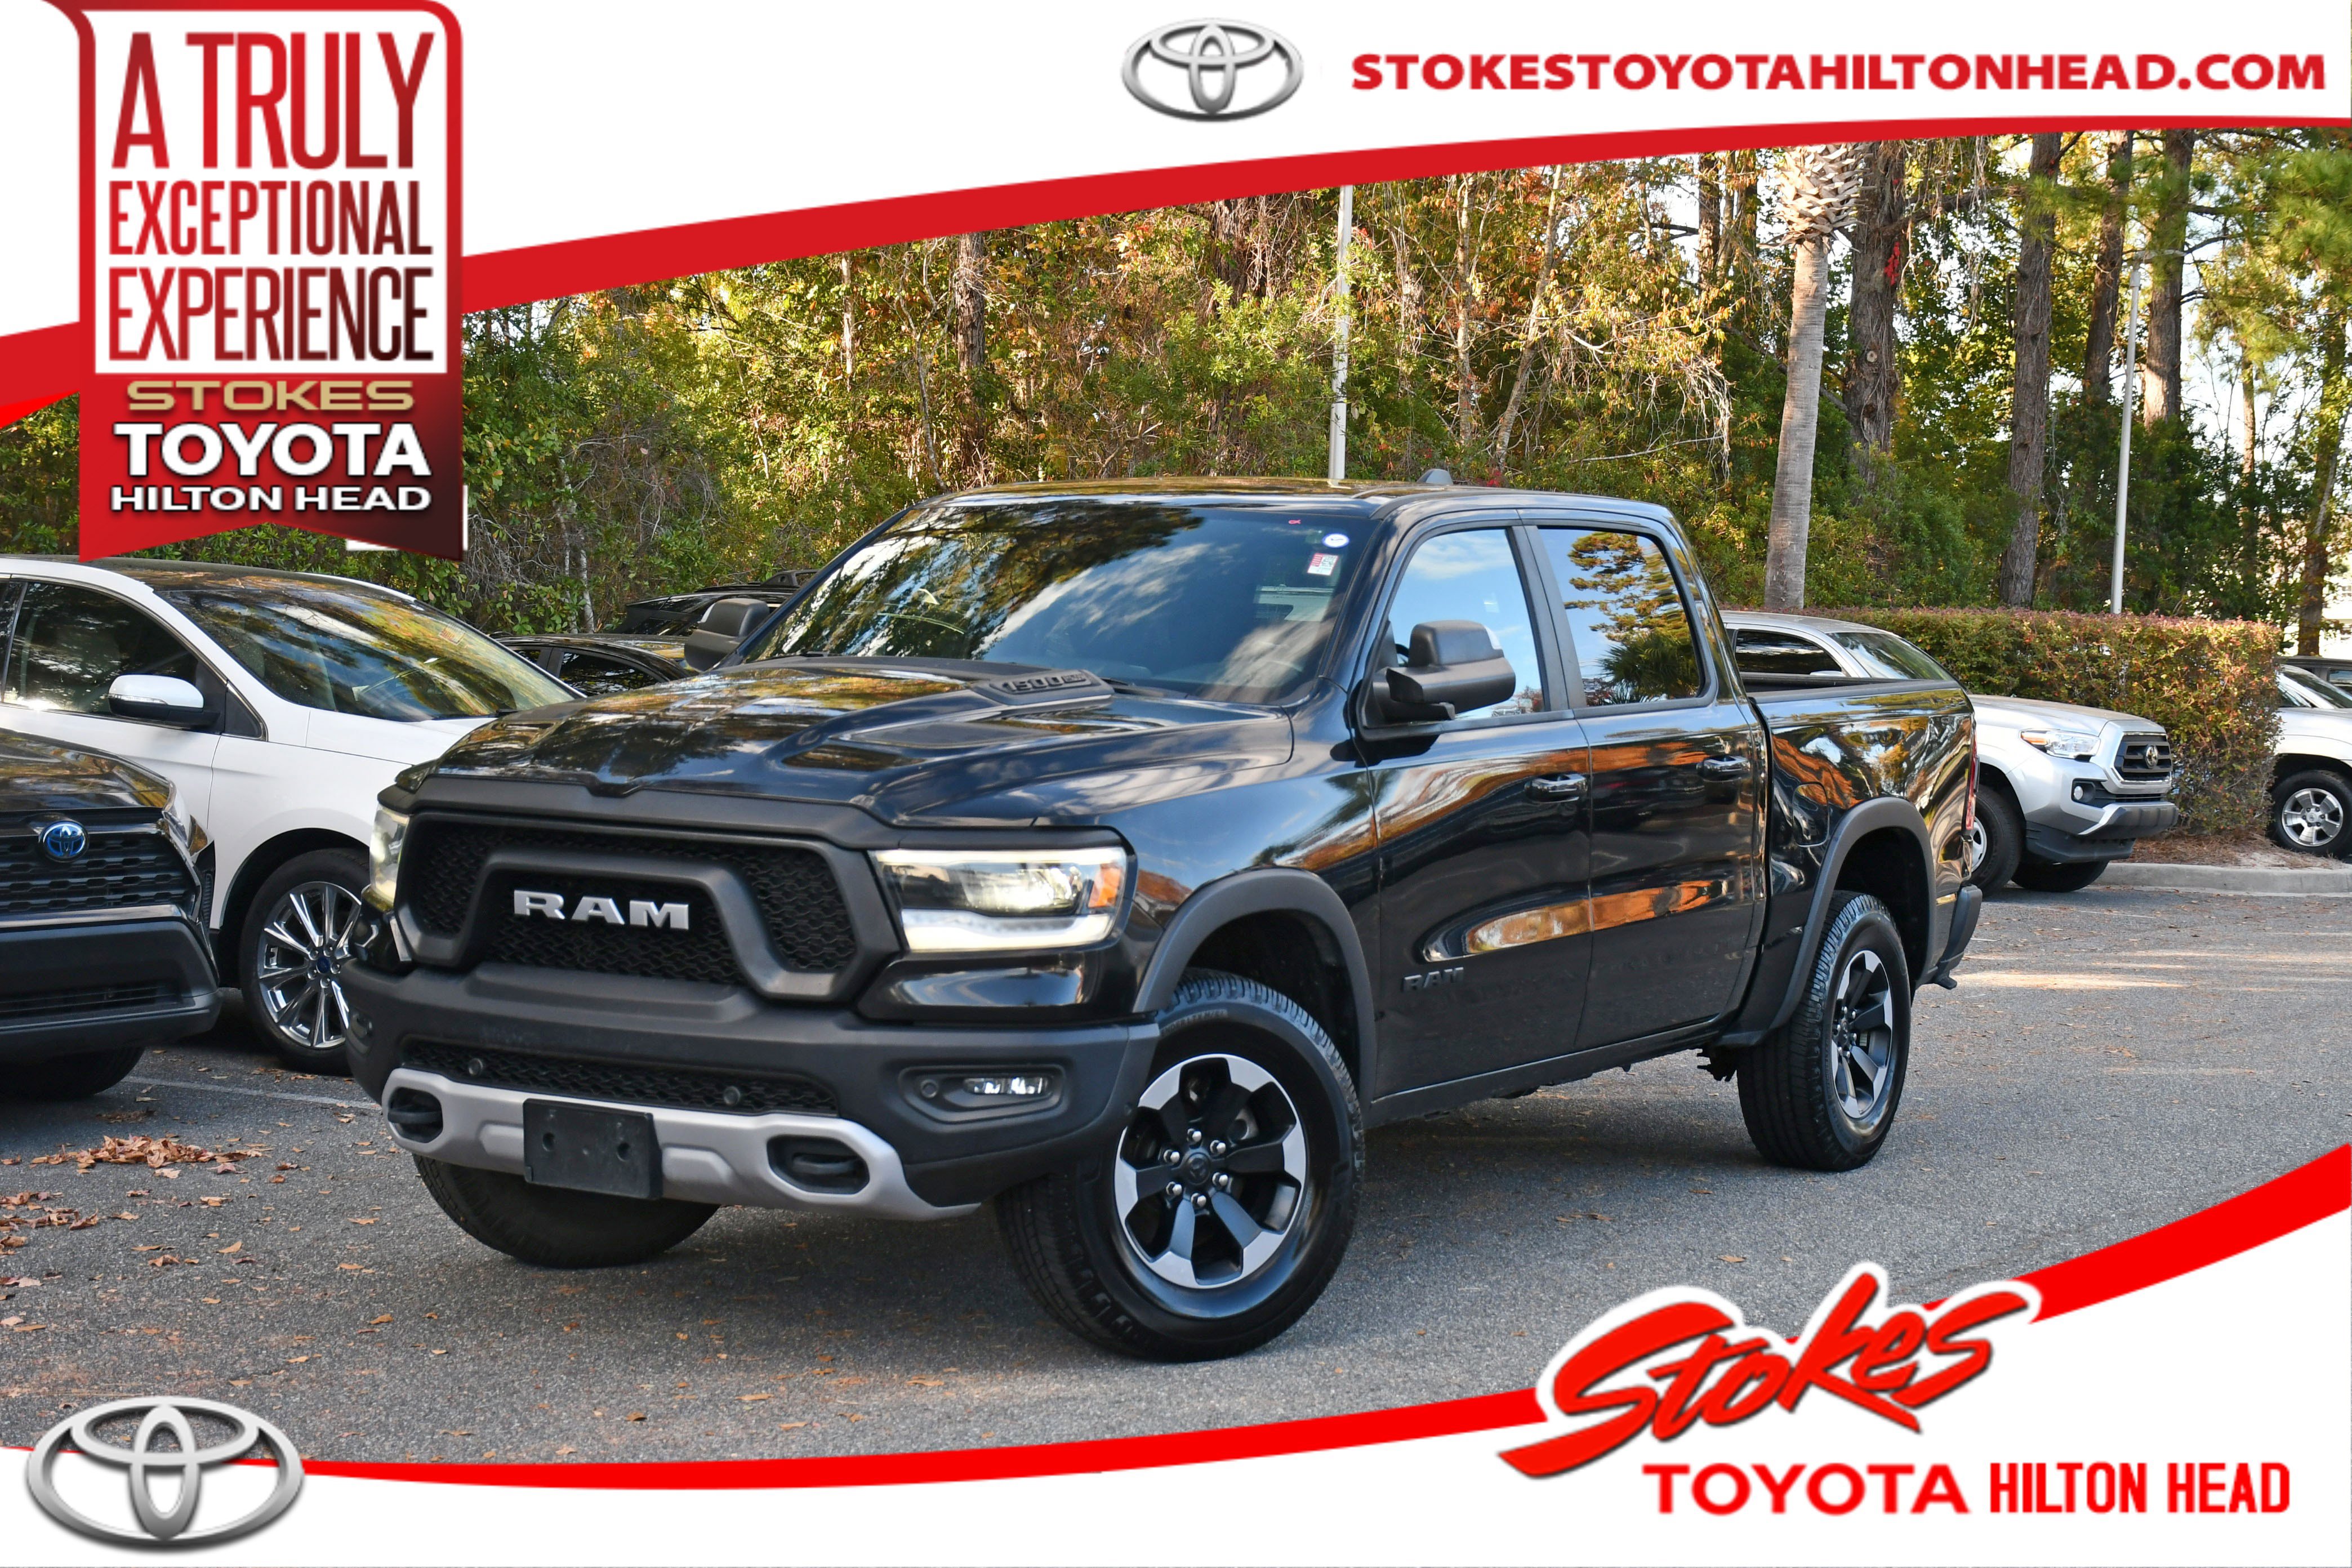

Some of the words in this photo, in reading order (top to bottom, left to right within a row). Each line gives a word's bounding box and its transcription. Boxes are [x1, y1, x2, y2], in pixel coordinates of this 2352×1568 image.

[1002, 676, 1064, 692] 1500
[514, 889, 689, 930] RAM
[1402, 966, 1464, 992] RAM
